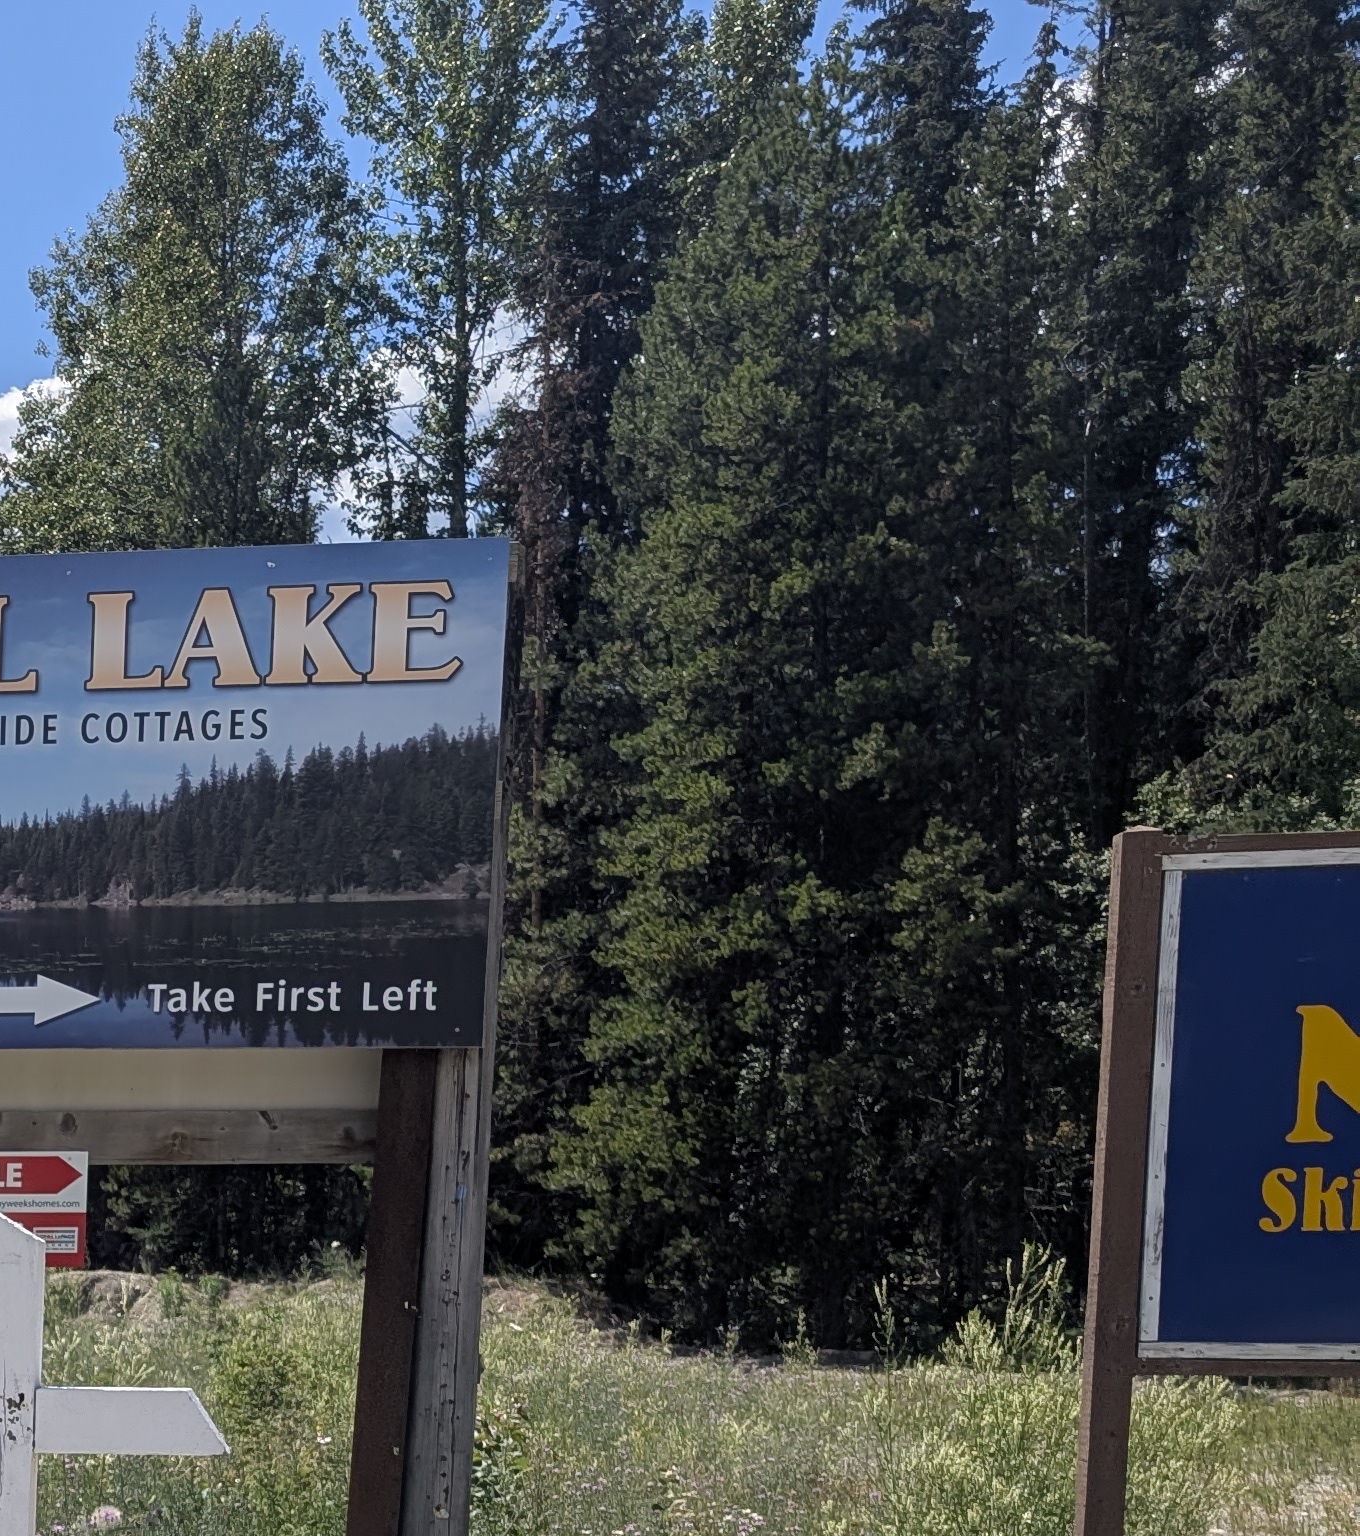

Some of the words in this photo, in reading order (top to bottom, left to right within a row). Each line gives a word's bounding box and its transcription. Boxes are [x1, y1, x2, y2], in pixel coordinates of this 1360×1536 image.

[84, 579, 464, 692] LAKE
[81, 708, 269, 745] COTTAGES
[147, 980, 235, 1013] Take
[255, 978, 342, 1013] First
[362, 978, 438, 1012] Left
